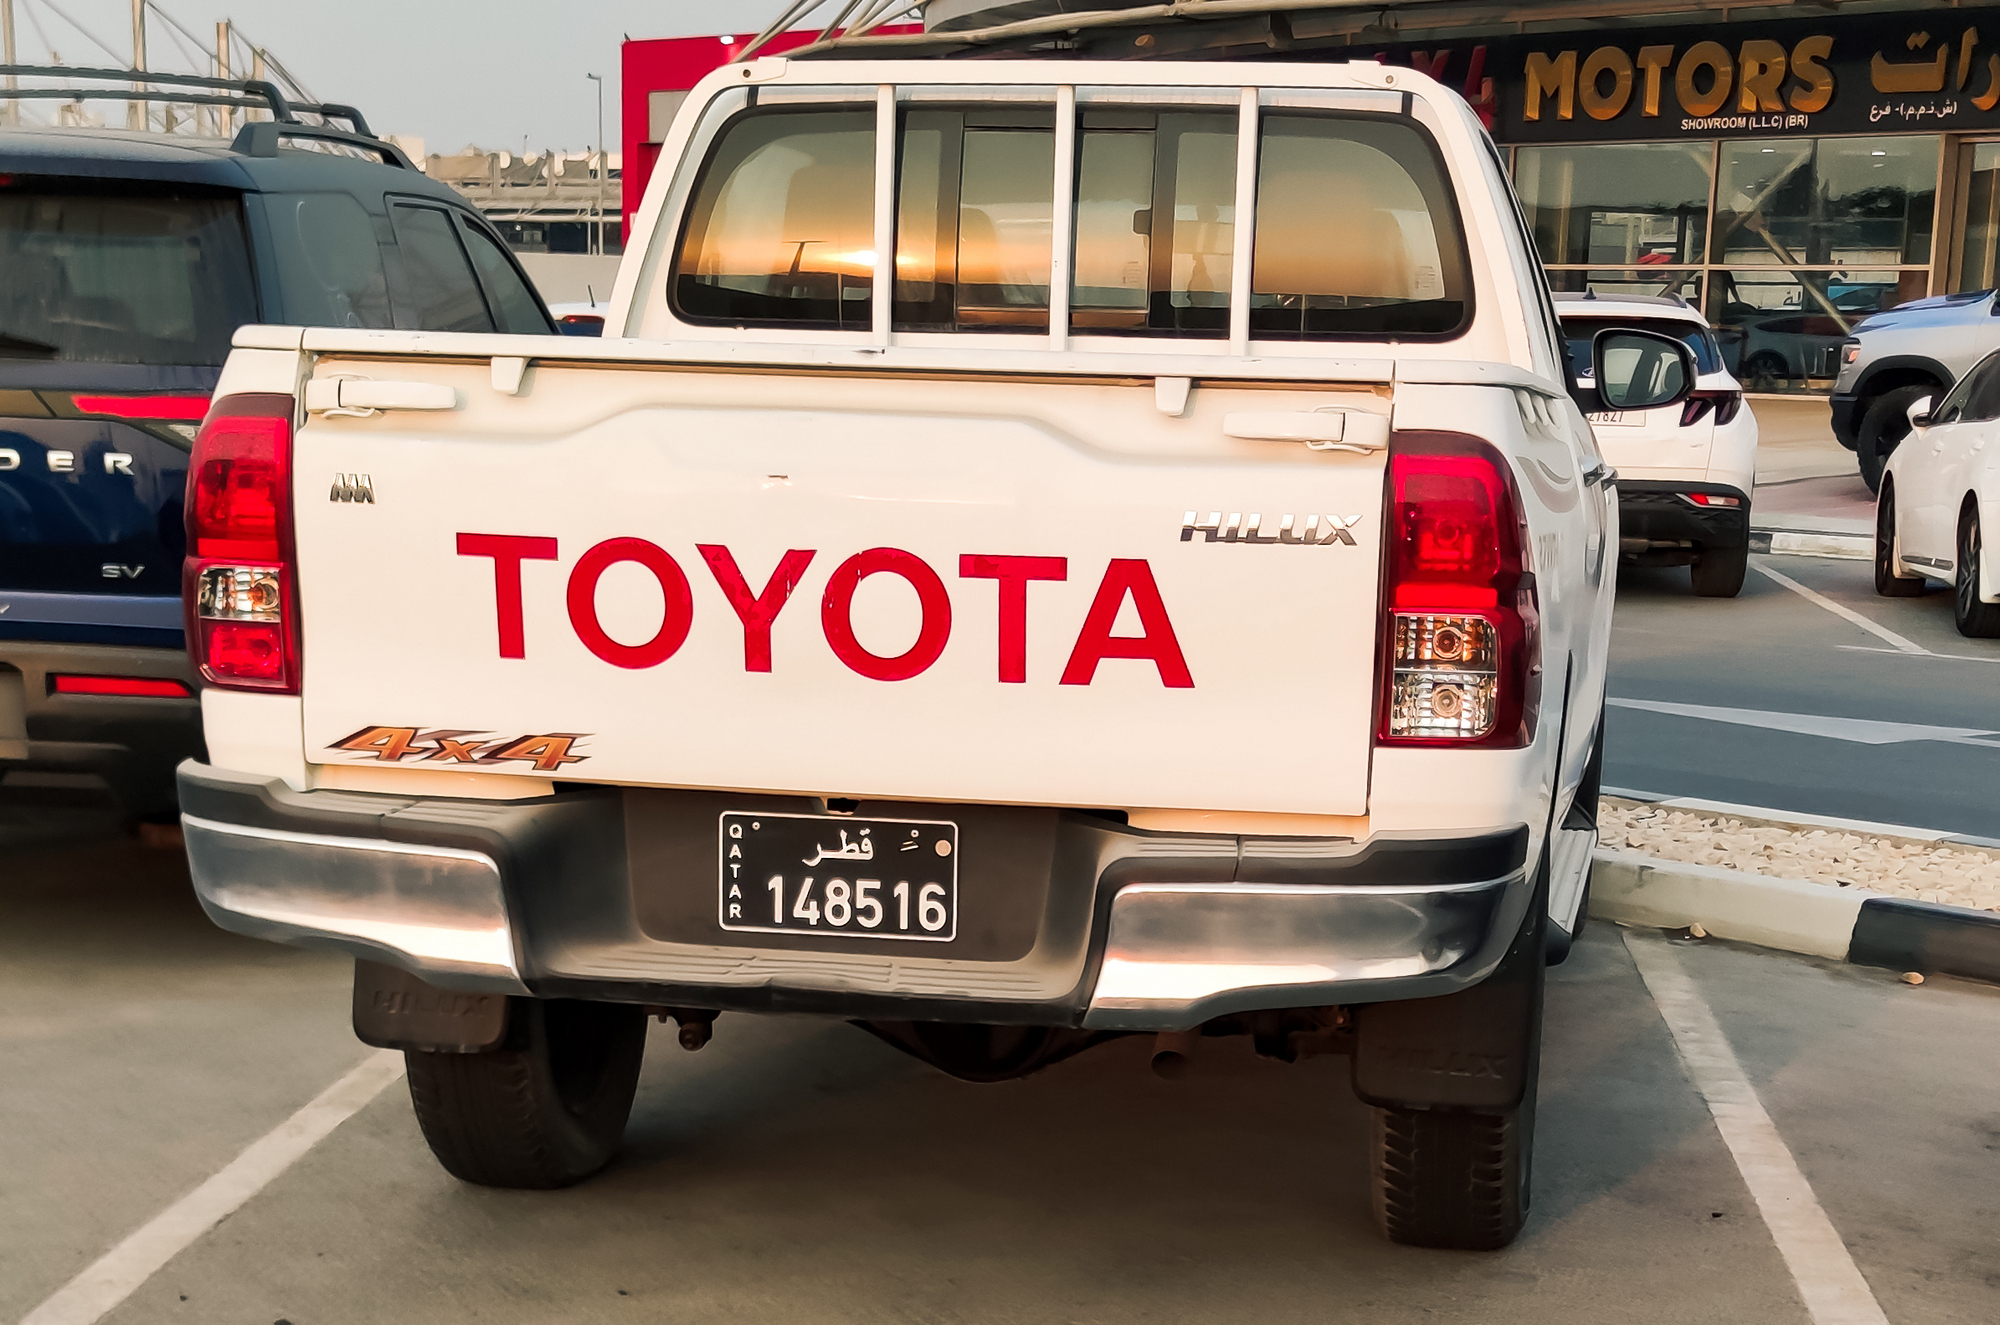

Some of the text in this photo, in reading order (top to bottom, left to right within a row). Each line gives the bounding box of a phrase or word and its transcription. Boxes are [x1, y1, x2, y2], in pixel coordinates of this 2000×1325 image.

[1523, 35, 1836, 122] MOTORS
[1681, 117, 1746, 130] SHOWROOM
[1785, 114, 1808, 129] (BR)
[1180, 510, 1363, 546] HILUX
[101, 563, 145, 579] SV
[456, 532, 1195, 689] TOYOTA
[728, 823, 743, 919] QATAR
[802, 828, 874, 867] قطر
[767, 874, 947, 932] 148516
